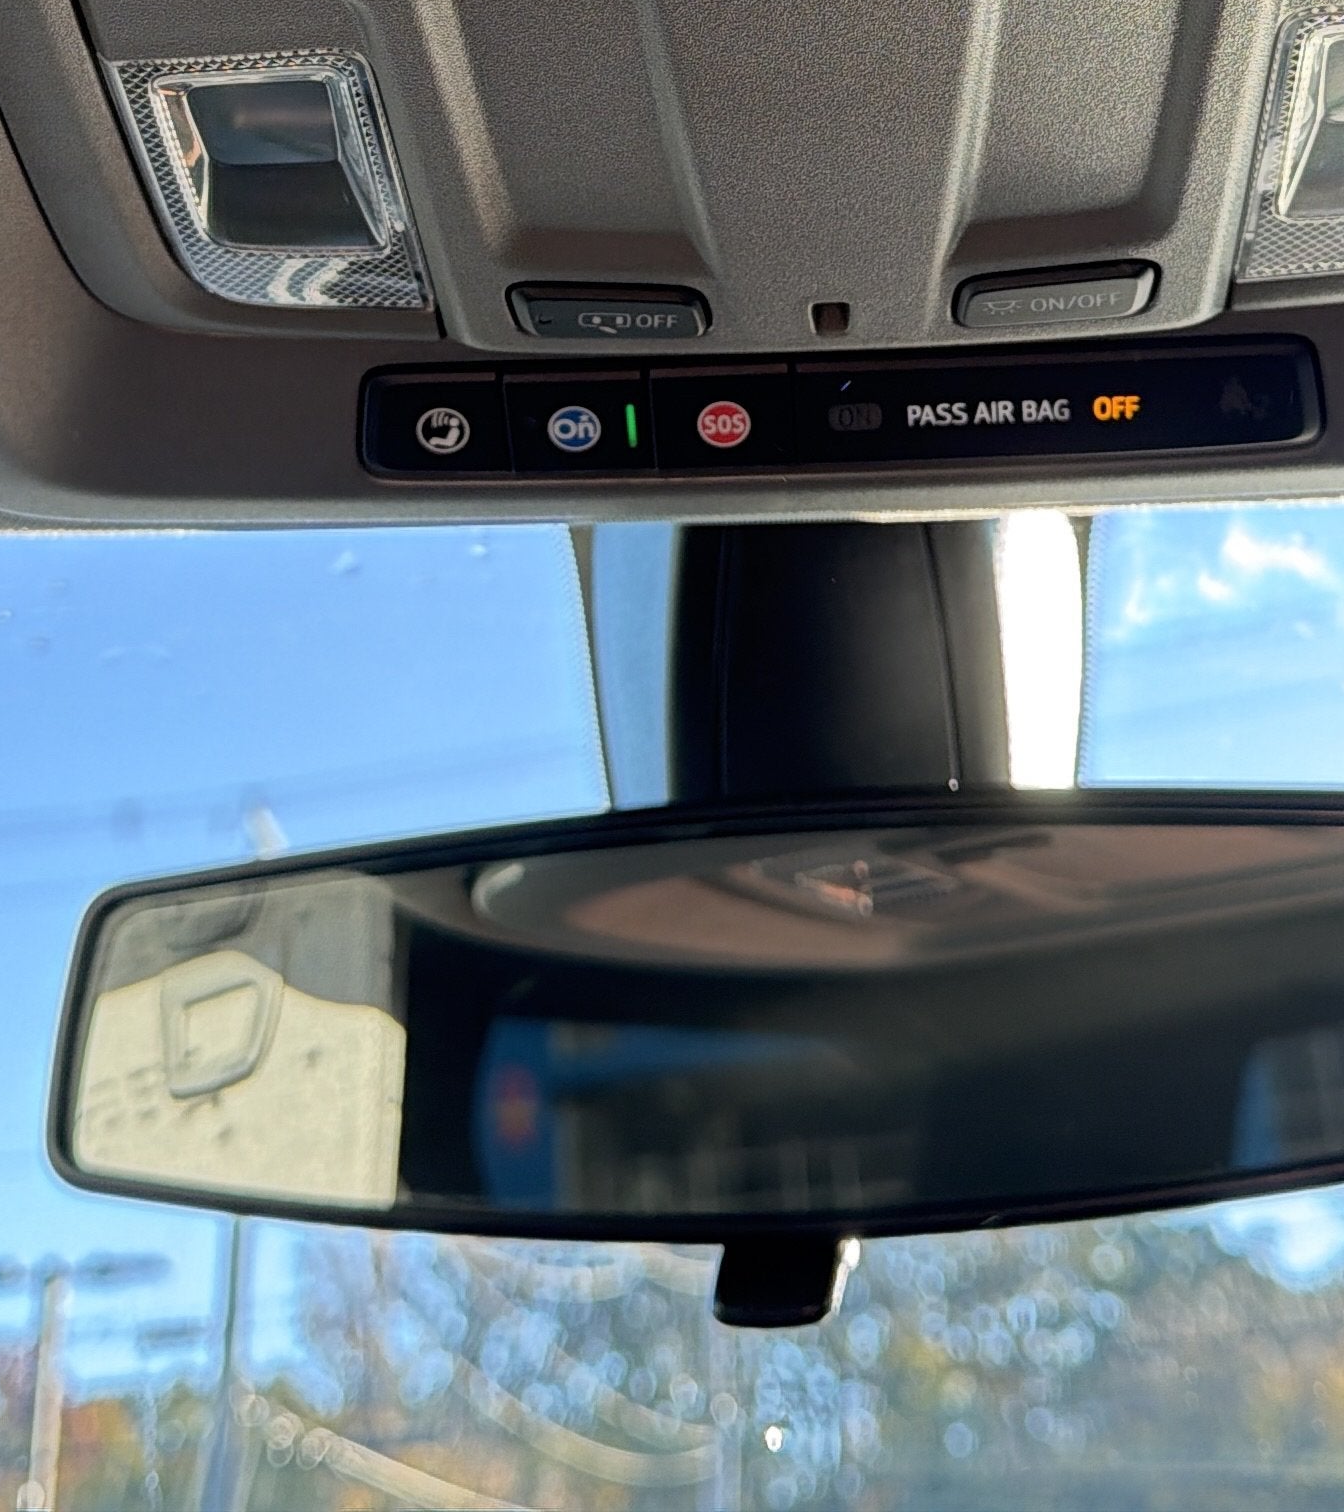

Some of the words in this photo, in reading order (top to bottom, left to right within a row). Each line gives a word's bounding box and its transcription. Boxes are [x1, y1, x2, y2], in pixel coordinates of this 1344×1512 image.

[1029, 292, 1122, 313] ON/OFF
[635, 313, 678, 329] OFF
[906, 402, 968, 427] PASS
[973, 400, 1015, 425] AIR
[1021, 398, 1071, 423] BAG
[1093, 395, 1140, 421] OFF
[703, 413, 745, 435] SOS
